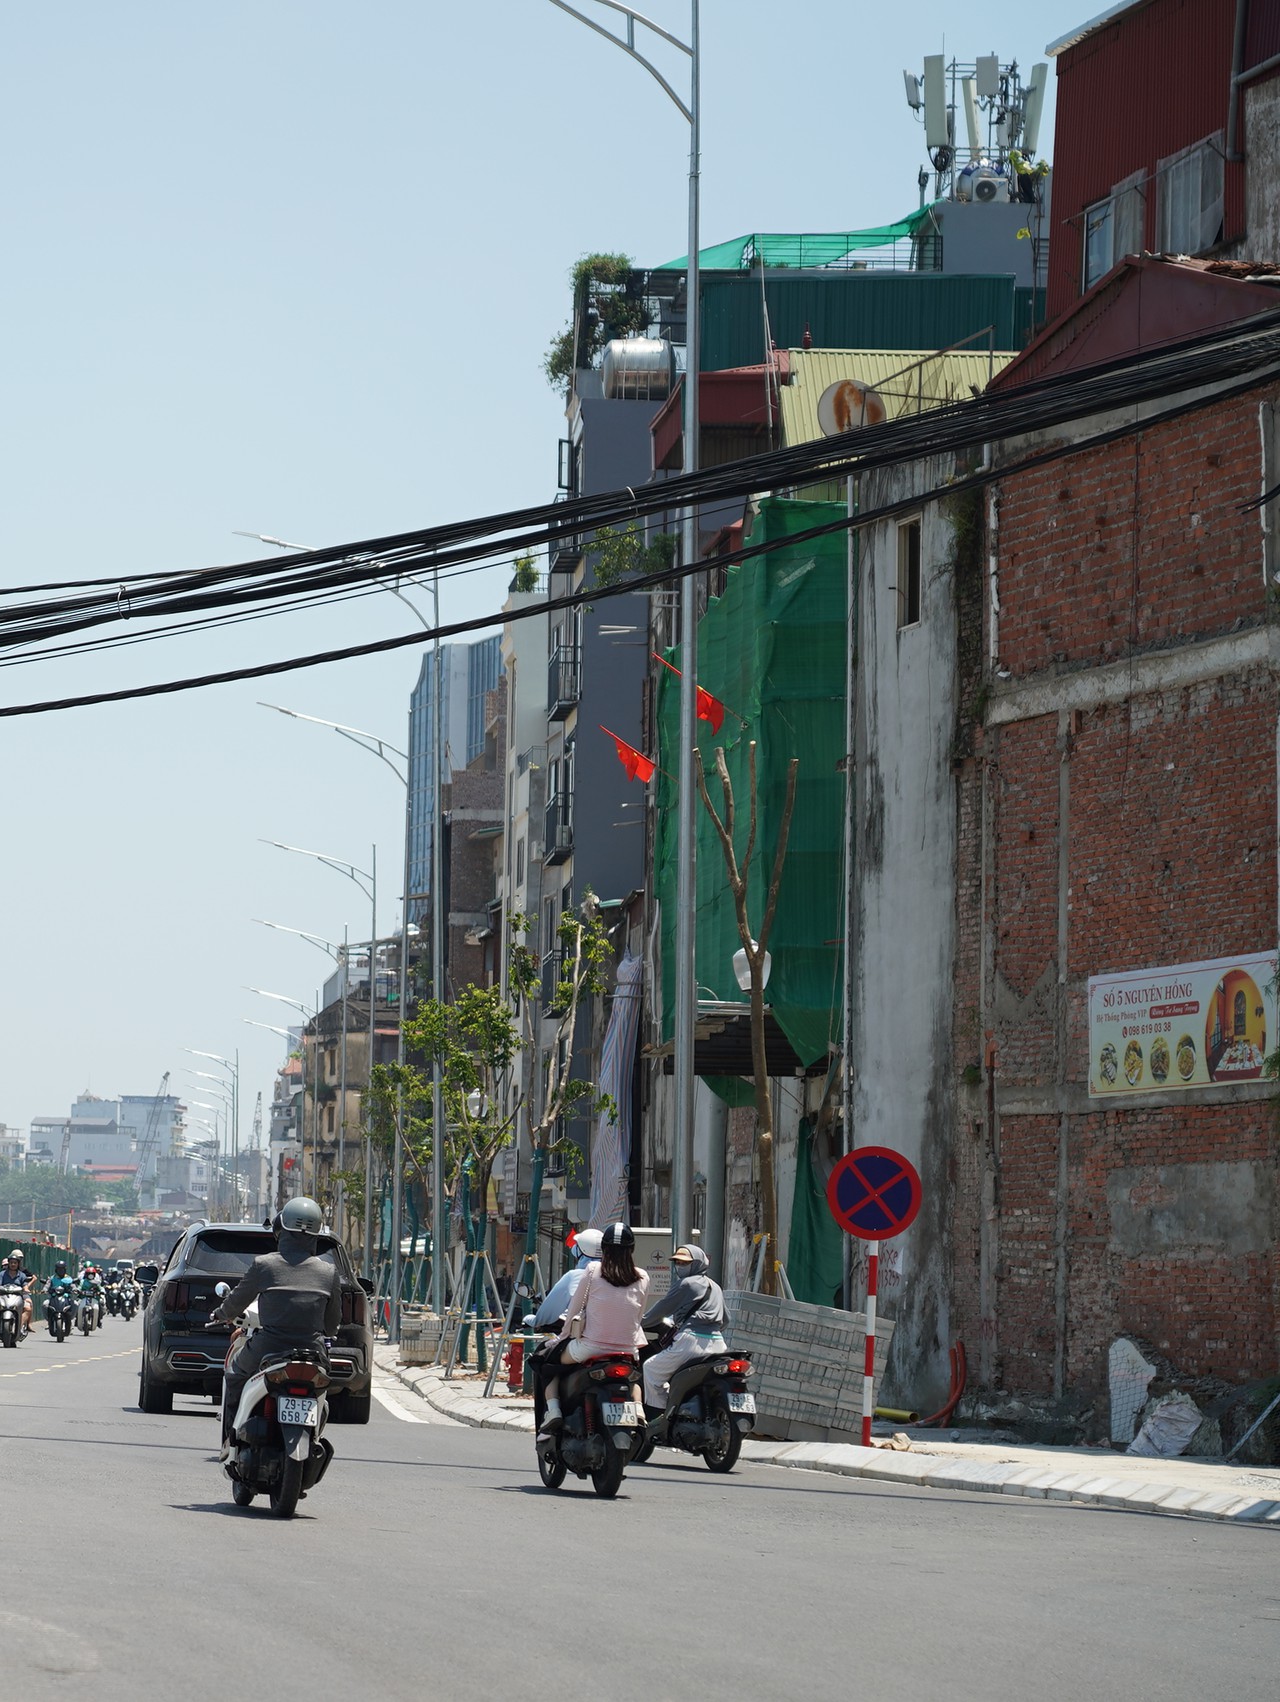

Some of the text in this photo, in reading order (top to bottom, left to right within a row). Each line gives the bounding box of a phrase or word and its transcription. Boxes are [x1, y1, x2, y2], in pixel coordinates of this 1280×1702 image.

[1103, 986, 1115, 1007] SỐ
[1117, 990, 1123, 1006] 5
[1124, 984, 1163, 1005] NGUYÊN
[1137, 1009, 1147, 1018] VIP
[1141, 1023, 1153, 1035] 619
[1154, 1022, 1162, 1033] 03
[1163, 1021, 1172, 1032] 38
[285, 1399, 312, 1411] 29-E2
[608, 1404, 632, 1414] 11-AA
[281, 1411, 315, 1424] 658.24
[606, 1414, 636, 1424] 072.49
